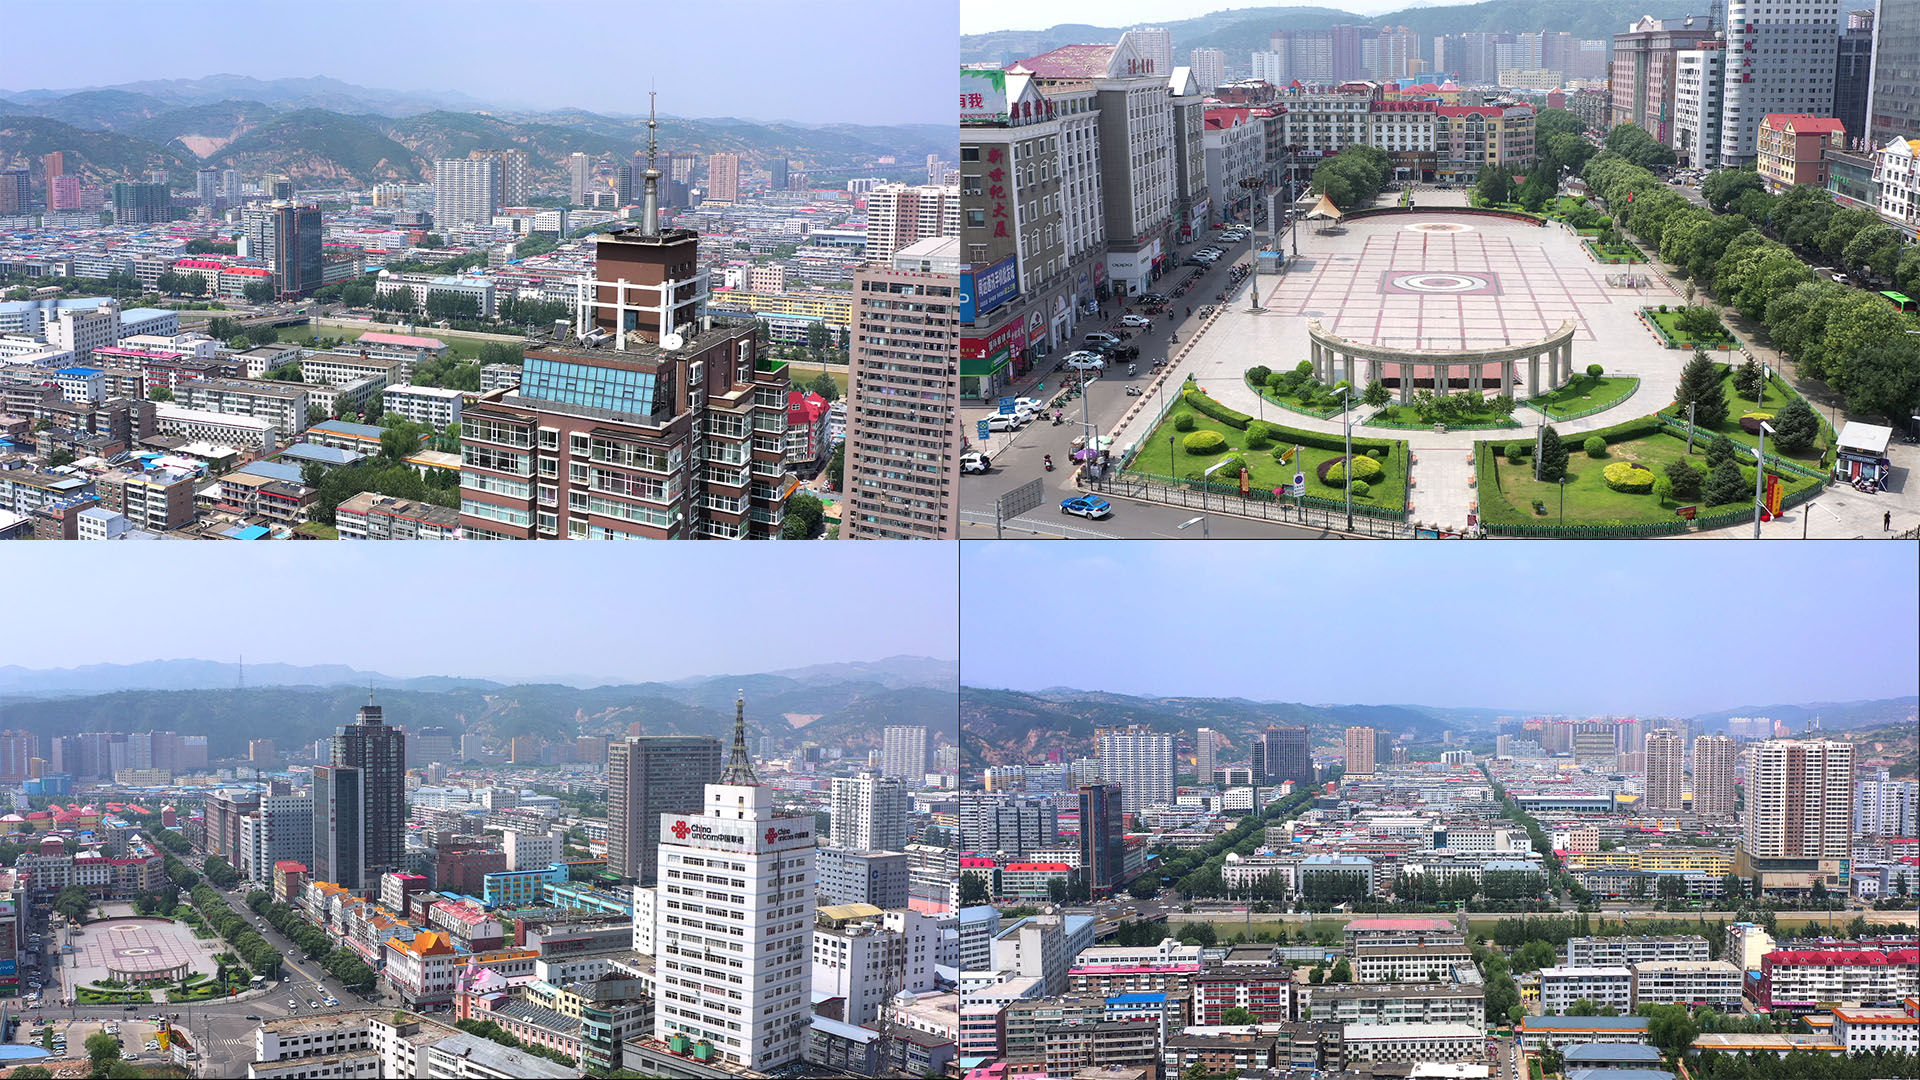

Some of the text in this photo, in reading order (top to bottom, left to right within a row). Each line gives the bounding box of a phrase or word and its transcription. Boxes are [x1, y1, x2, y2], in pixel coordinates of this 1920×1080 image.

[987, 147, 1011, 238] 新世纪大厦
[691, 824, 711, 833] China
[719, 833, 744, 844] 中国联通
